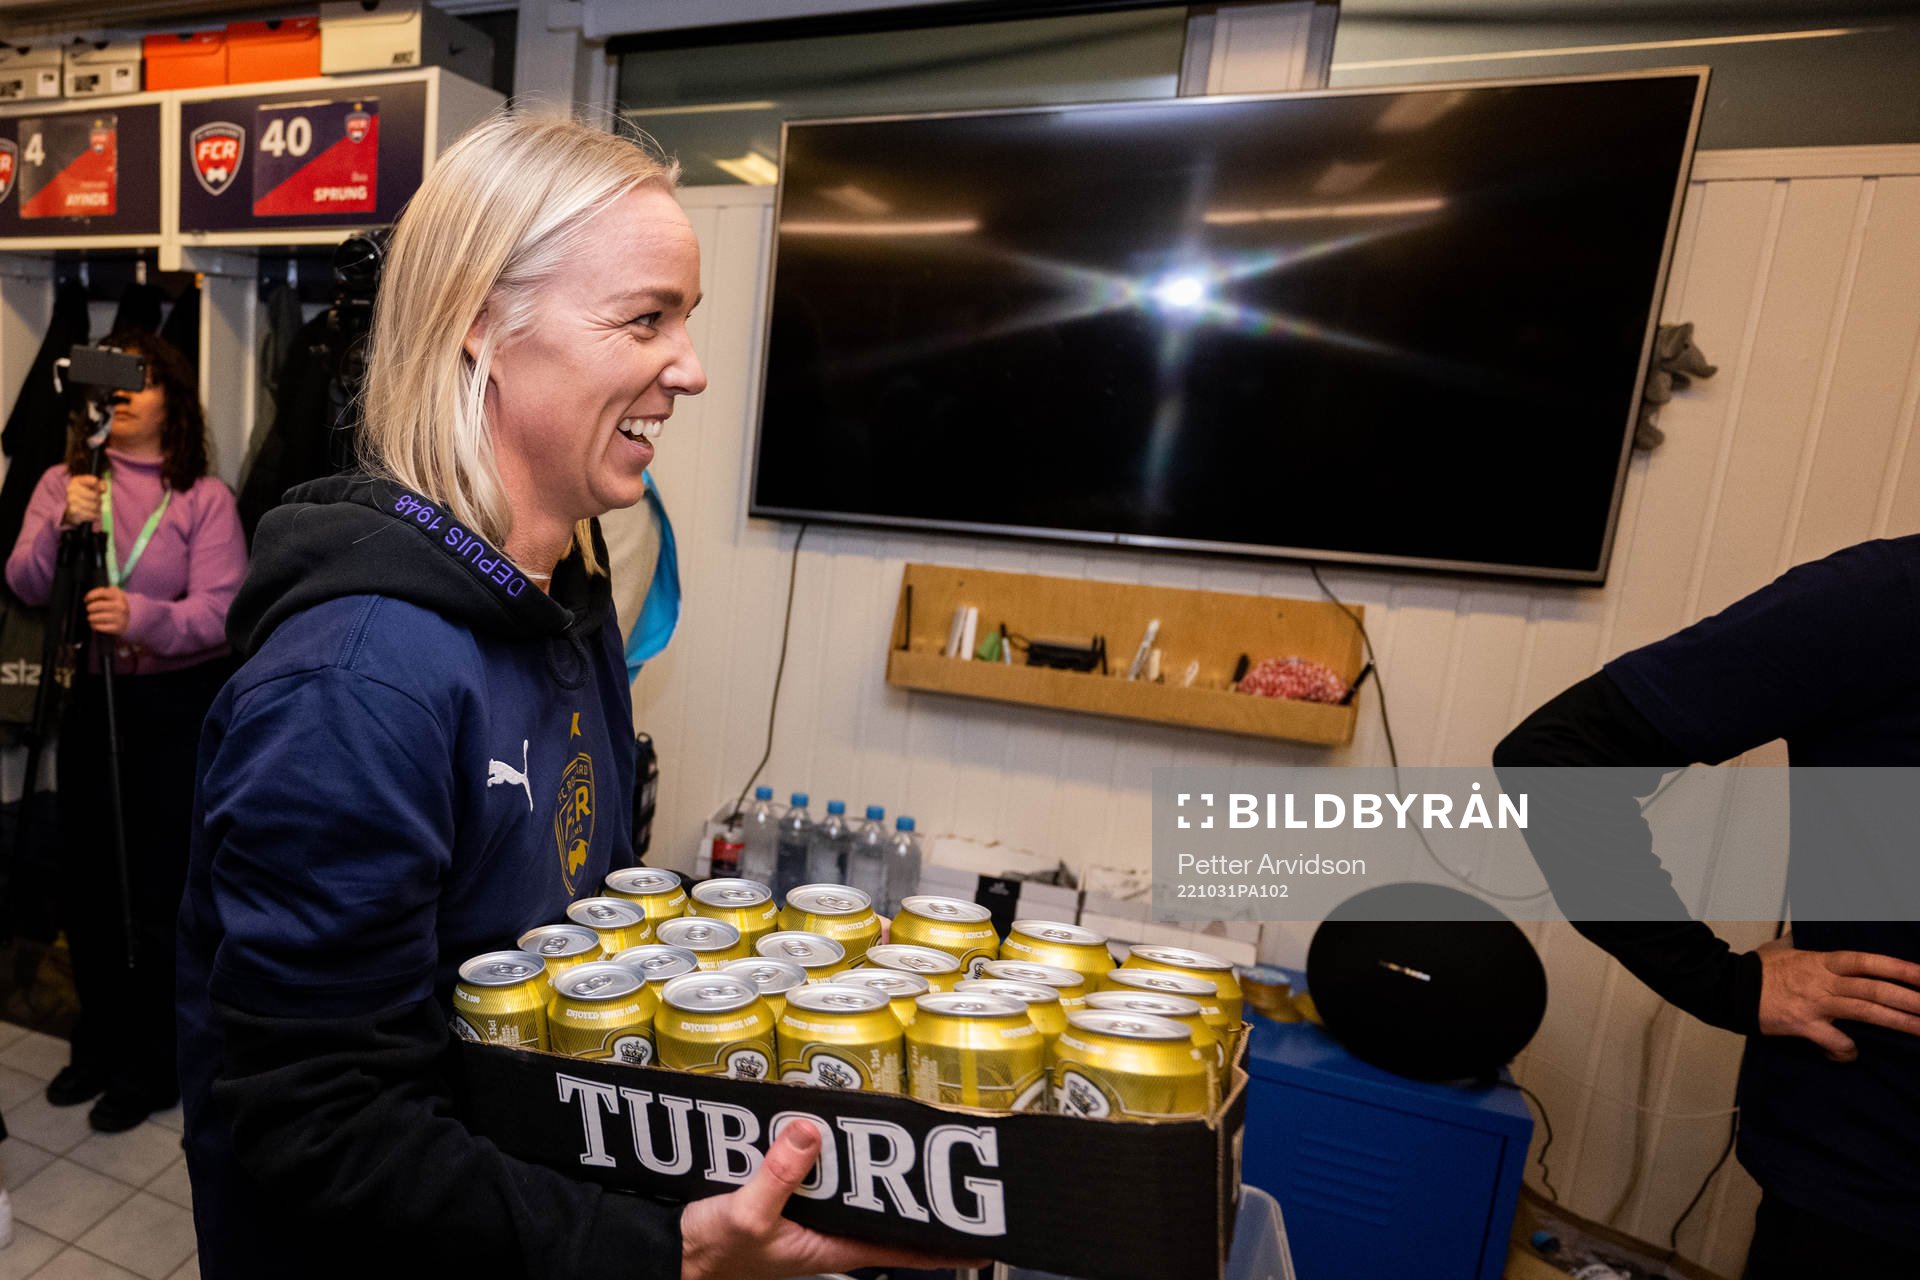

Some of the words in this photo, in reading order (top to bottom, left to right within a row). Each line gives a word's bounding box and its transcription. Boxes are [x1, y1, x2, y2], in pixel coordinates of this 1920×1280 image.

[24, 133, 46, 167] 4
[198, 140, 238, 161] FCR
[259, 116, 312, 157] 40
[313, 185, 368, 202] SPRUNG
[394, 495, 444, 531] 1948
[445, 527, 527, 598] DEPUIS
[555, 1072, 1007, 1237] TUBORG
